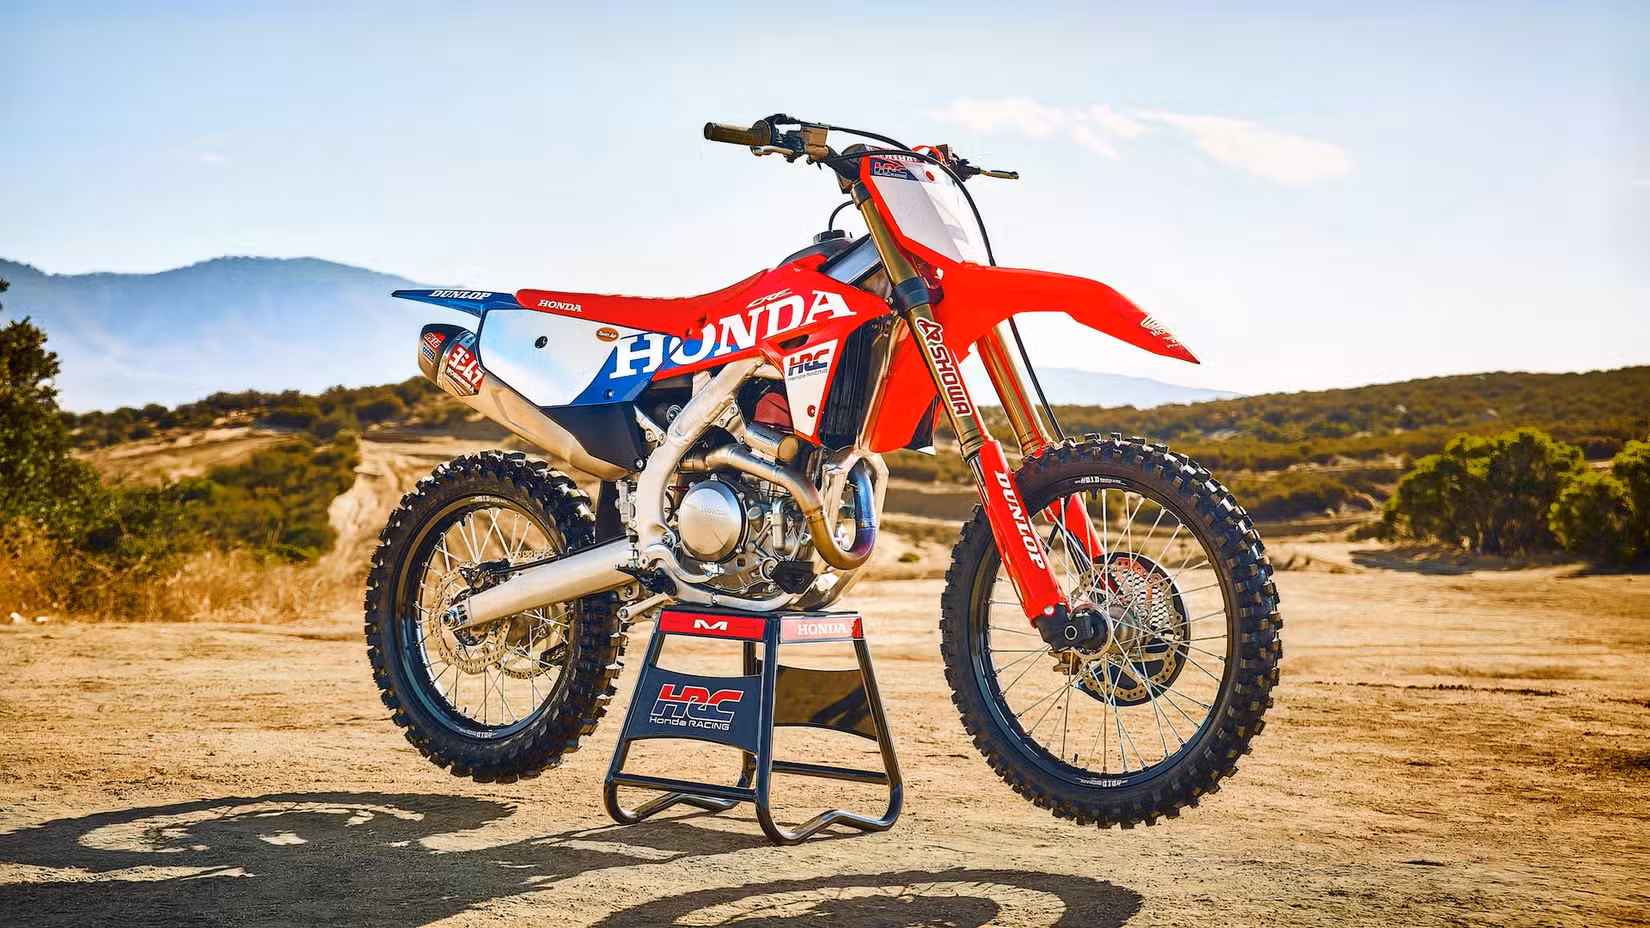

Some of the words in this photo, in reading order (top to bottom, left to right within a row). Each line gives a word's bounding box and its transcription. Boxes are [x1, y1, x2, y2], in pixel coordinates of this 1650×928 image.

[429, 289, 492, 300] DUNLOP
[537, 299, 582, 313] HONDA
[609, 289, 857, 380] HONDA
[788, 348, 829, 377] HRC
[930, 346, 972, 416] SHOWA
[994, 470, 1047, 570] DUNLOP
[796, 622, 847, 635] HONDA
[650, 683, 744, 724] HRC
[649, 716, 687, 727] Honda
[687, 719, 730, 731] RACING
